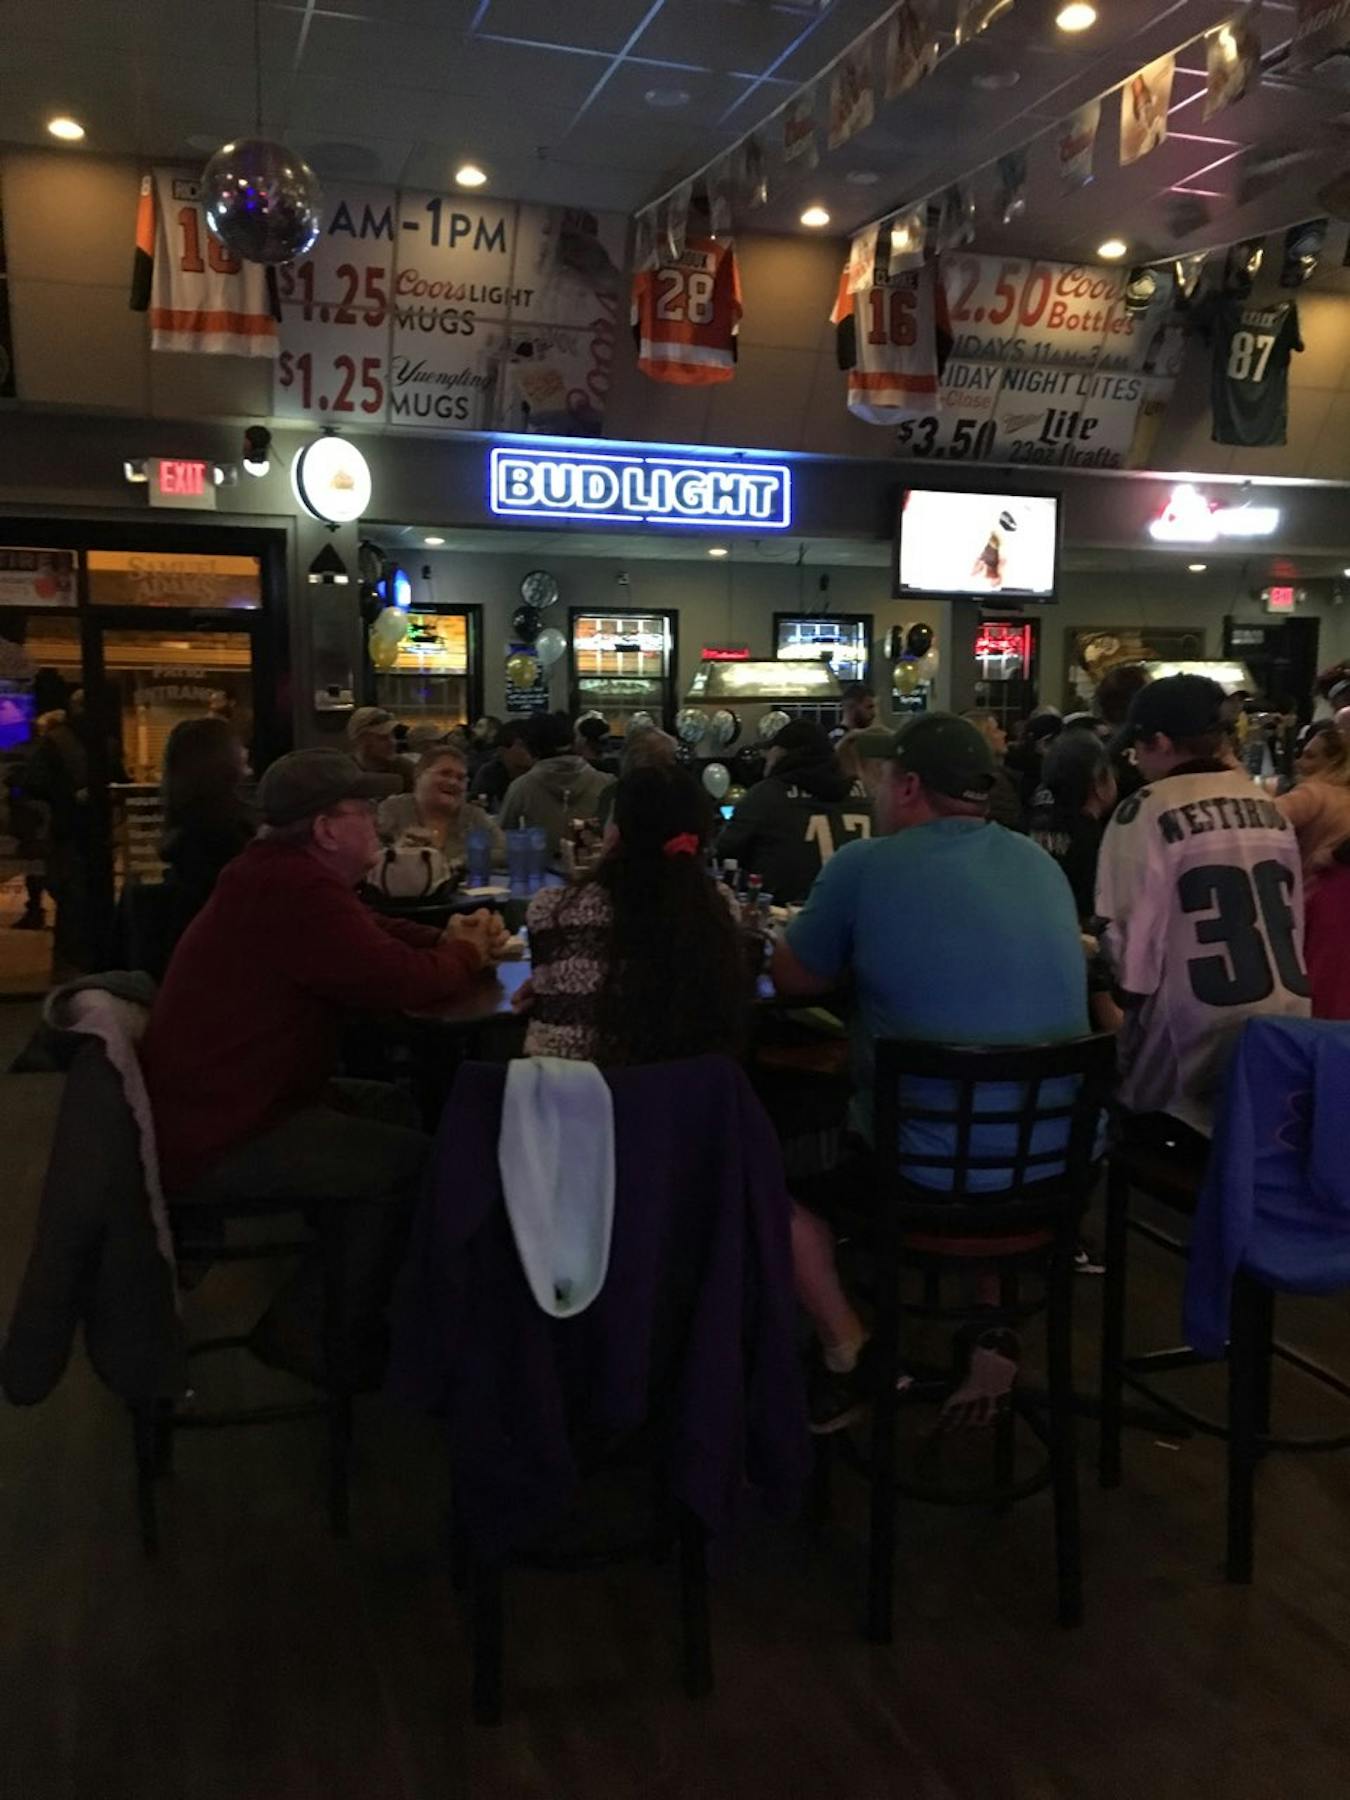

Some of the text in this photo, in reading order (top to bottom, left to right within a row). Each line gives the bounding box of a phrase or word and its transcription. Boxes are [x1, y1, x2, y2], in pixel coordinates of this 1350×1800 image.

[279, 260, 387, 328] $1.25
[396, 268, 535, 307] Coors LIGHT
[656, 268, 715, 325] 28
[393, 303, 475, 336] MUGS
[867, 287, 918, 347] 16
[1046, 301, 1134, 336] Bottles
[391, 355, 495, 390] Yuengling
[1227, 331, 1276, 383] 87
[278, 350, 384, 414] $1.25
[1000, 366, 1077, 396] NIGHT
[391, 392, 469, 420] MUGS
[897, 415, 998, 461] $3.50
[1038, 408, 1099, 446] Lite
[159, 461, 205, 496] EXIT
[498, 459, 780, 518] BUD LIGHT
